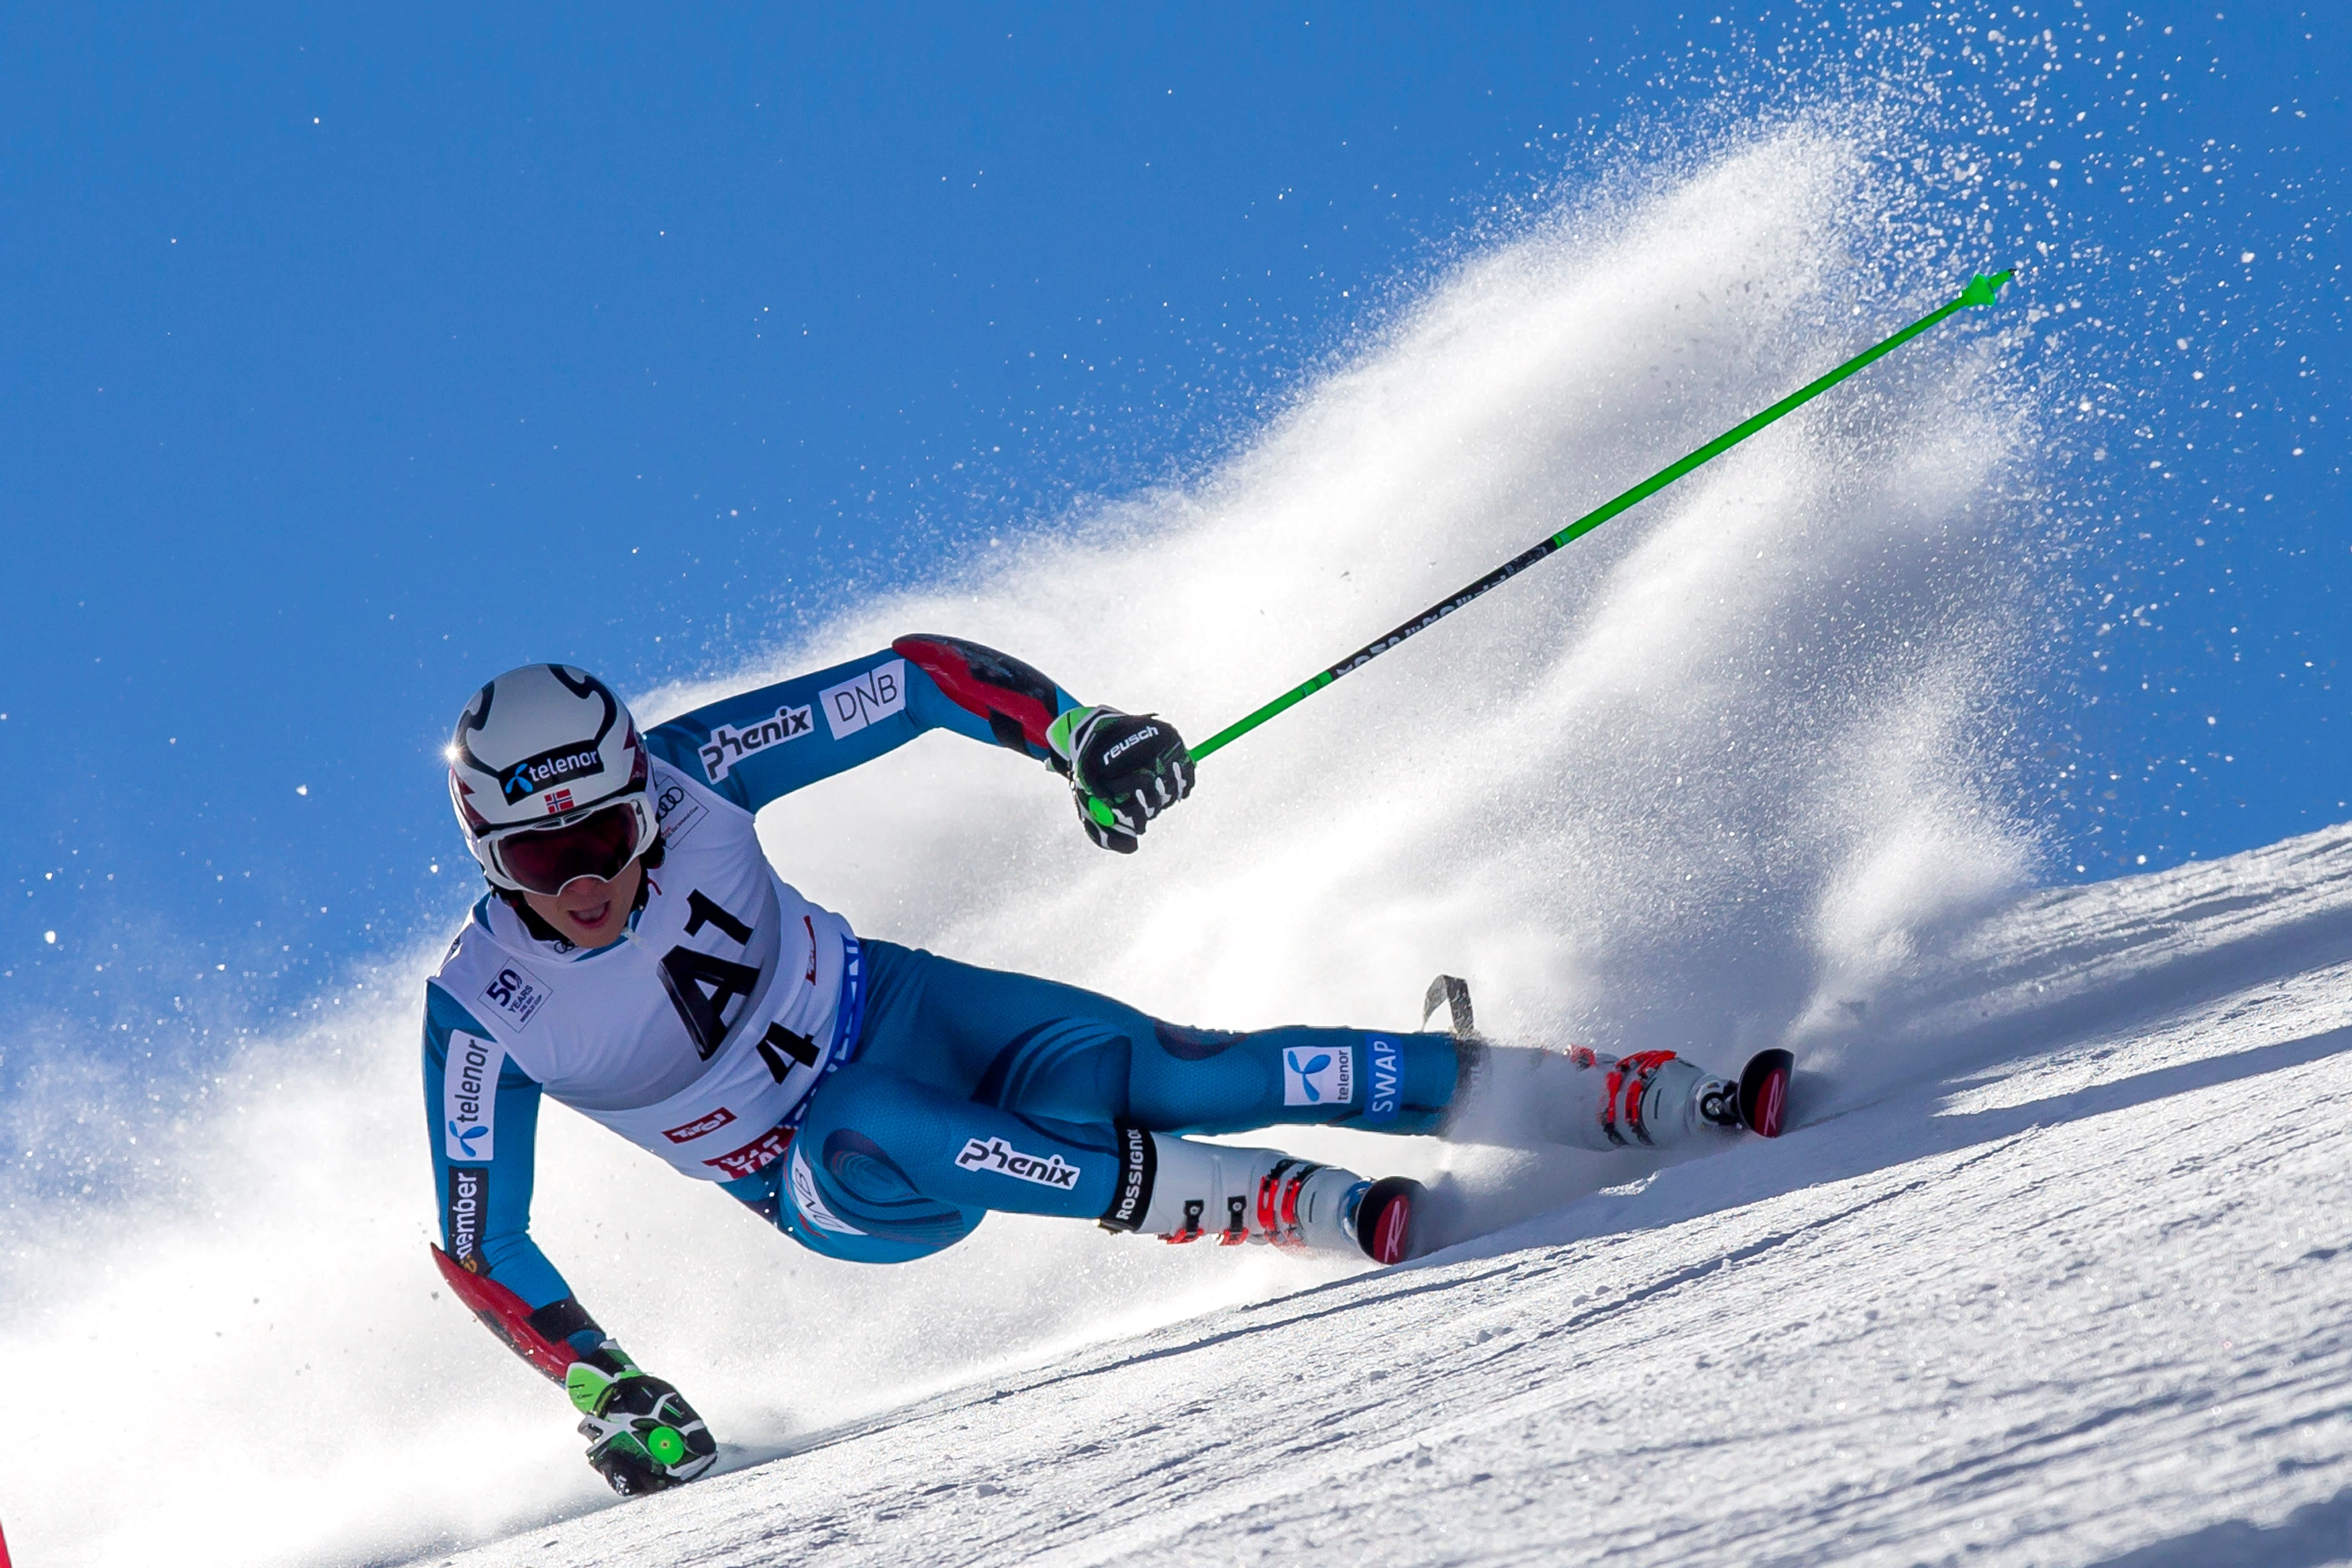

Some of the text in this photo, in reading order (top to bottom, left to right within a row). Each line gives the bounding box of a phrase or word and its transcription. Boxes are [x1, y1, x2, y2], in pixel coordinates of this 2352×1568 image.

[834, 671, 897, 726] DNB
[529, 750, 598, 781] telenor
[702, 708, 810, 780] phenix
[1103, 726, 1159, 765] reusch
[486, 969, 522, 1007] 50
[508, 985, 533, 1012] YEARS
[657, 889, 762, 1062] A1
[756, 1021, 820, 1084] 4
[1337, 1050, 1348, 1101] telenor
[1372, 1041, 1396, 1112] SWAP
[455, 1039, 489, 1123] telenor
[672, 1113, 726, 1137] Tirol
[960, 1142, 1077, 1186] phenix
